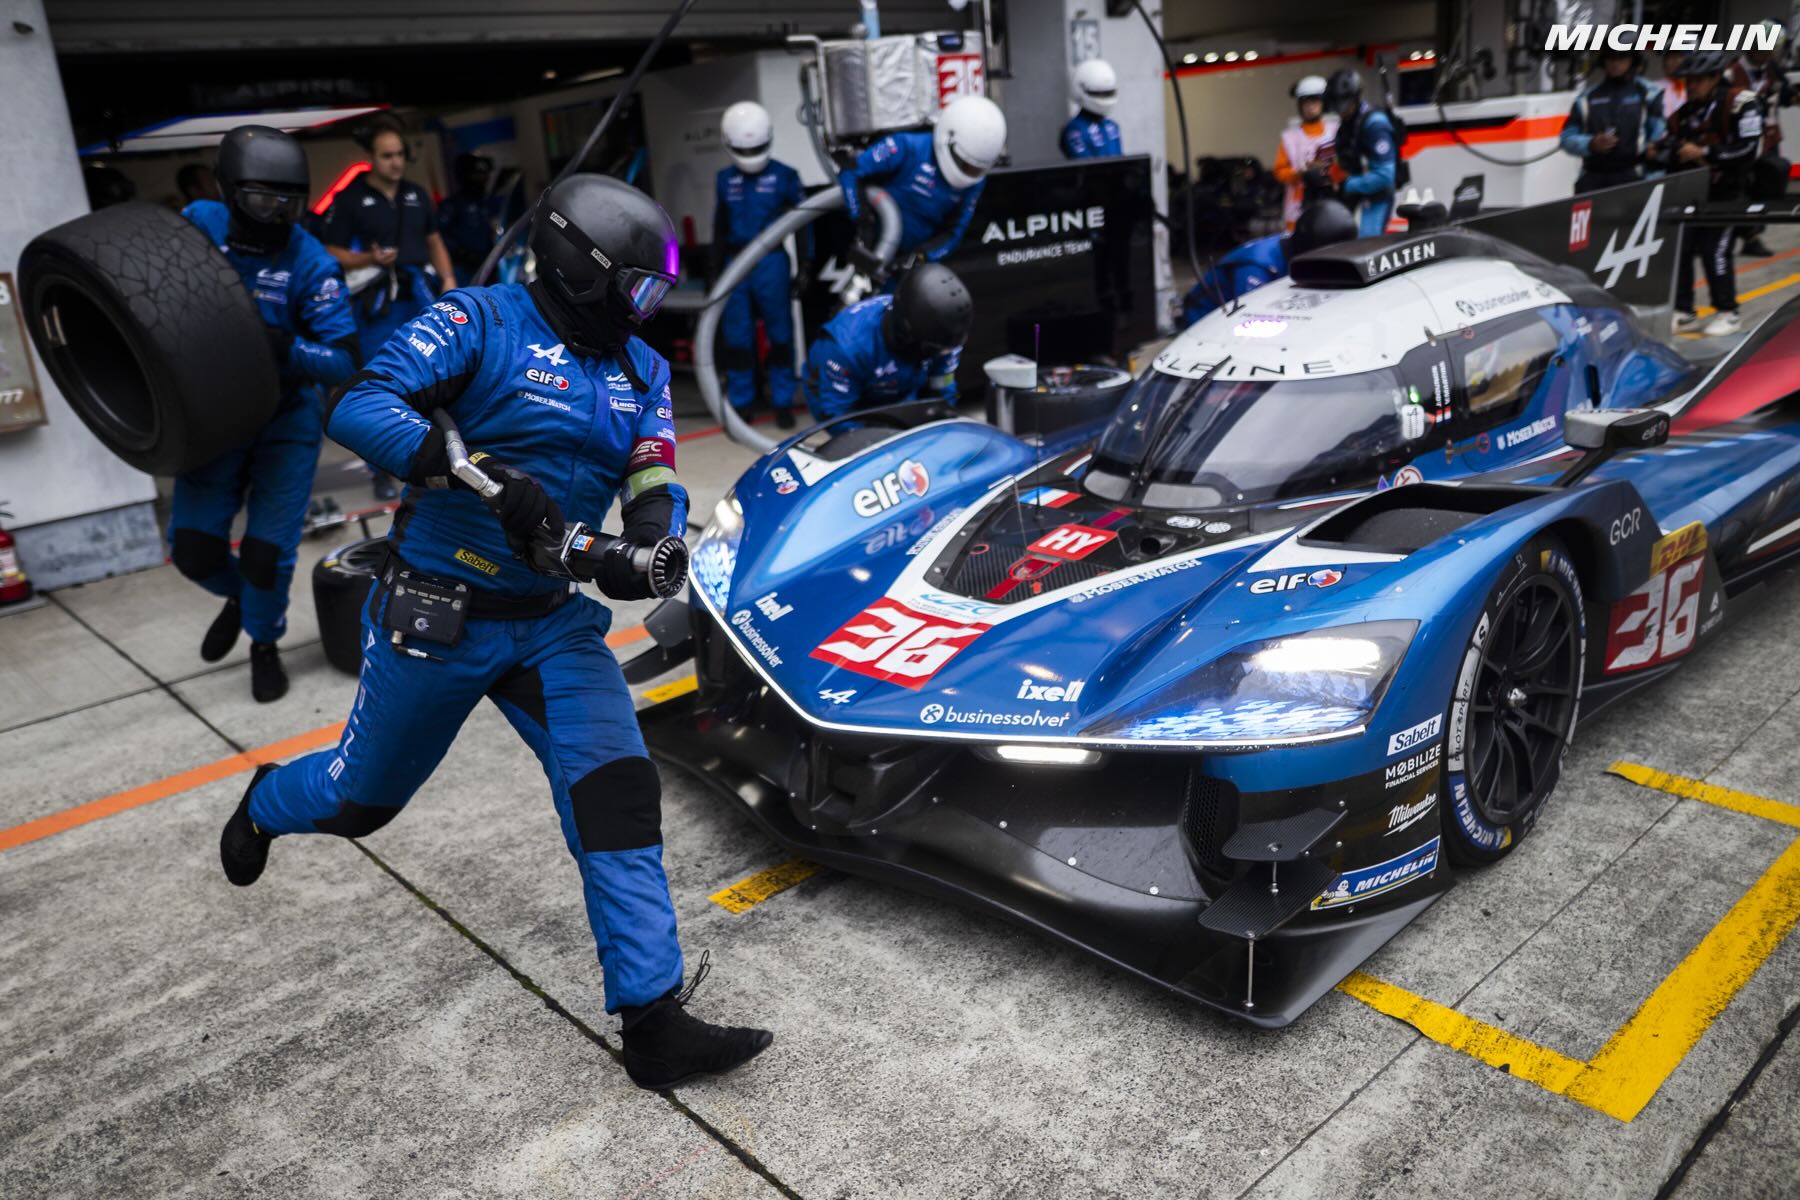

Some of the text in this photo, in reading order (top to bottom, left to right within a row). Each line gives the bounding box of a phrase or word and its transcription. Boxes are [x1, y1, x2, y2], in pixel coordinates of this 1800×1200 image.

[982, 205, 1105, 244] ALPINE
[1570, 207, 1592, 245] HY
[1379, 241, 1436, 272] ALTEN
[408, 333, 438, 358] ixell
[525, 368, 555, 385] elf
[1158, 353, 1336, 377] ALPINE
[853, 472, 901, 518] elf
[1039, 528, 1107, 554] HY
[1609, 507, 1642, 546] GCR
[459, 550, 496, 574] Sabelt
[1659, 524, 1702, 568] DHL
[1249, 573, 1307, 594] elf
[754, 591, 795, 622] ixell
[1607, 556, 1705, 670] 36
[738, 616, 784, 669] businessolver
[816, 606, 986, 678] 36
[1016, 678, 1086, 702] ixell
[944, 706, 1070, 728] businessolver
[1394, 719, 1437, 752] Sabelt
[1385, 743, 1442, 781] MØBILIZE
[1385, 772, 1416, 789] FINANCIAL
[1387, 793, 1437, 829] Milwaukee
[1453, 782, 1495, 847] MICHELIN
[1354, 849, 1438, 893] MICHELIN
